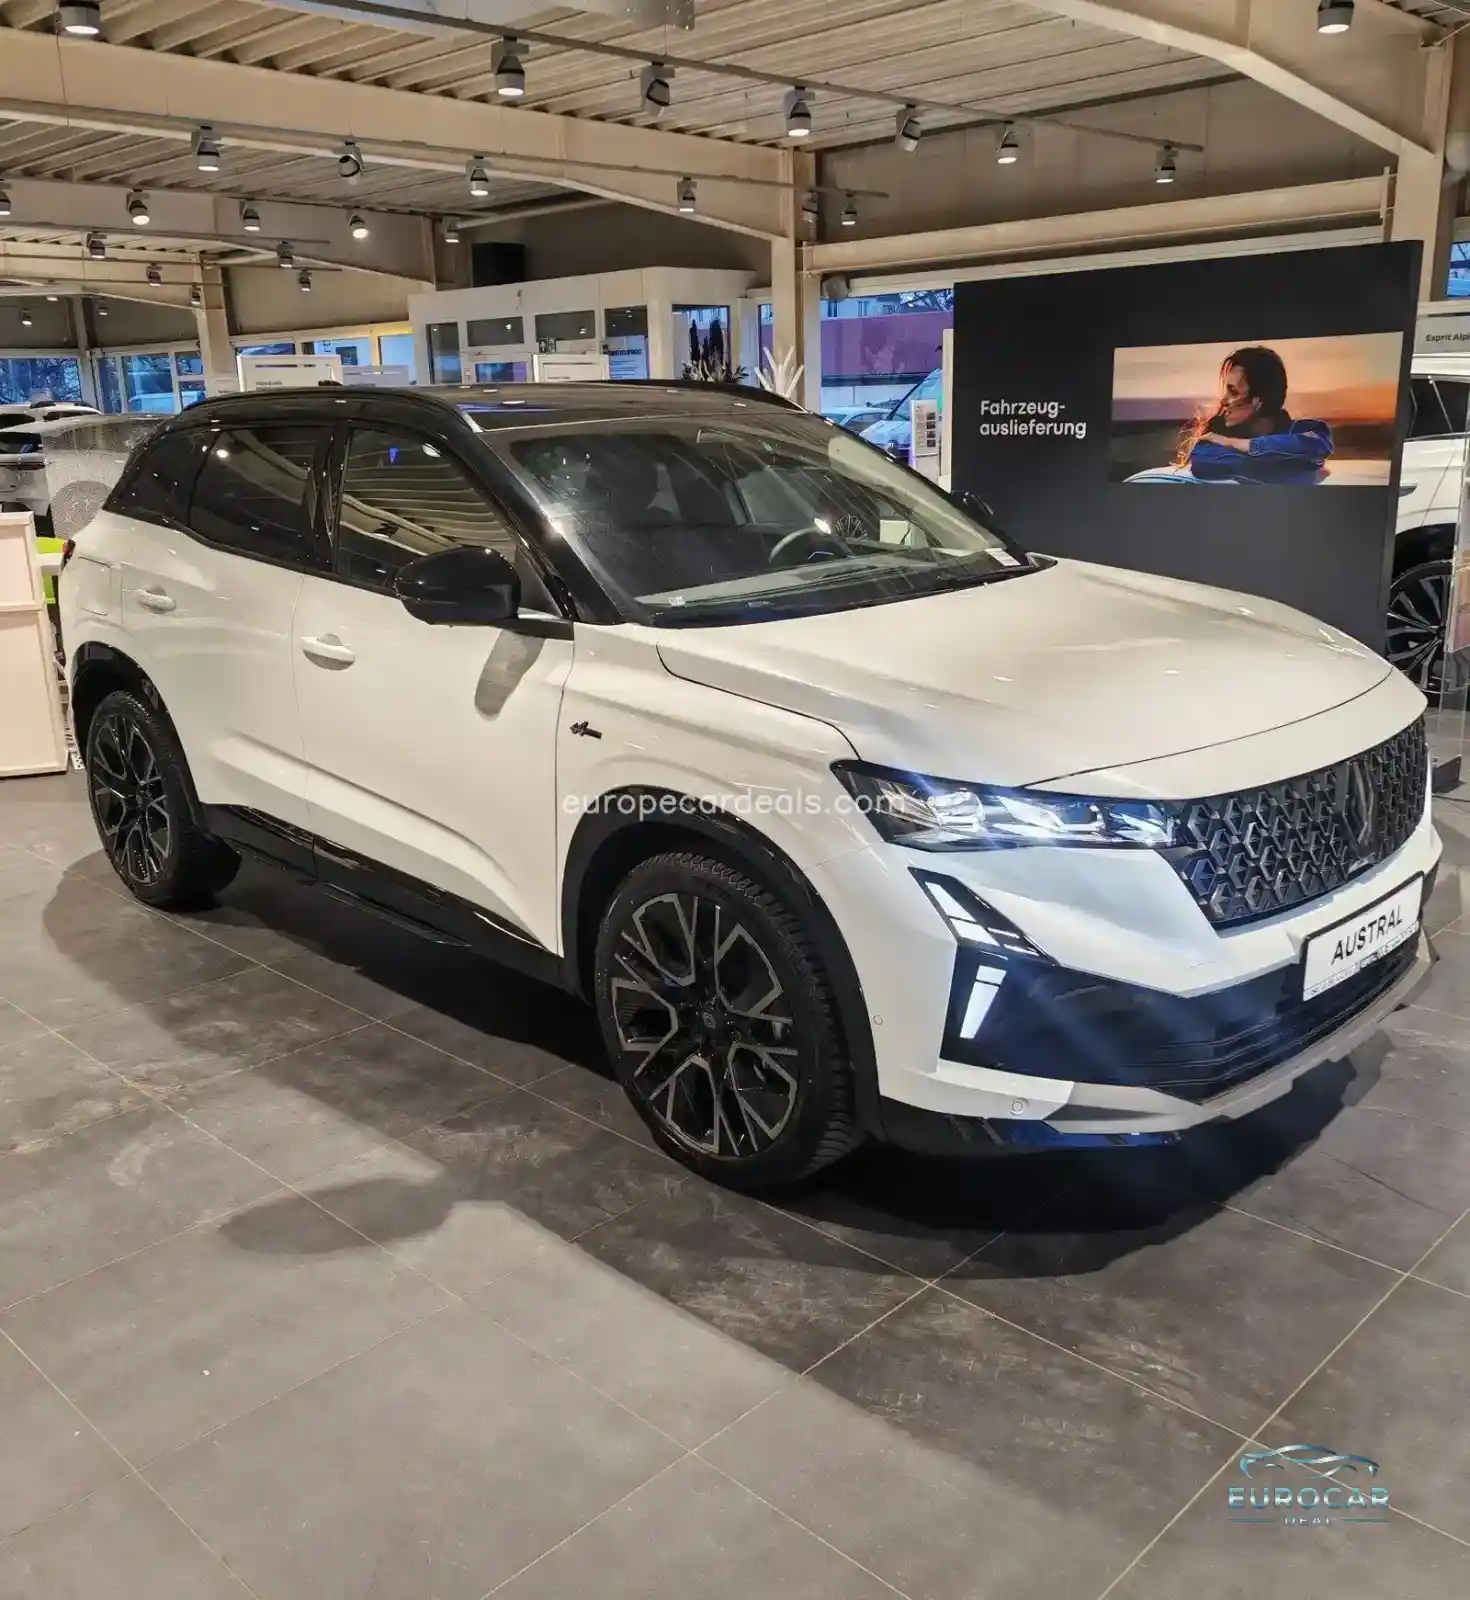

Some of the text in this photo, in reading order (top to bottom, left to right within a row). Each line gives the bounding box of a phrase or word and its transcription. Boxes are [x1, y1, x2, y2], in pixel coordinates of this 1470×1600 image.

[1425, 333, 1451, 343] Esprit
[980, 399, 1066, 419] Fahrzeug-
[980, 419, 1087, 439] auslieferung
[1330, 904, 1403, 966] AUSTRAL
